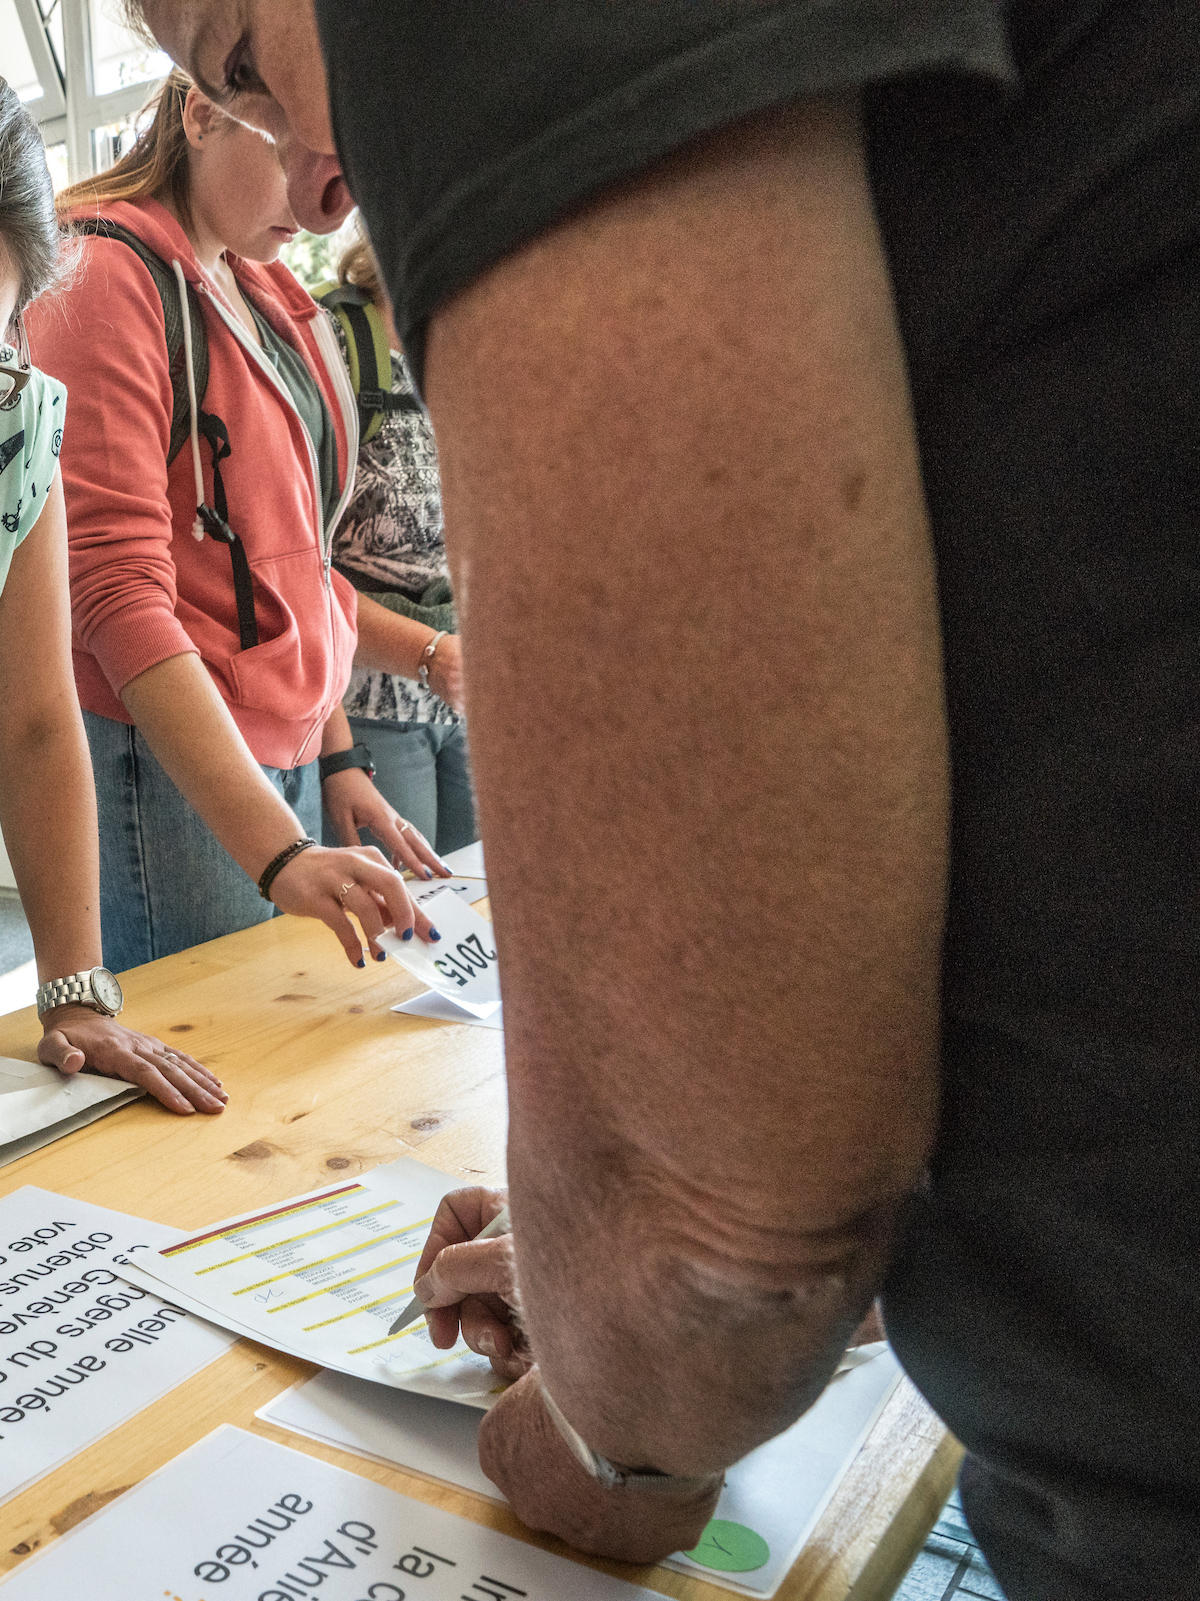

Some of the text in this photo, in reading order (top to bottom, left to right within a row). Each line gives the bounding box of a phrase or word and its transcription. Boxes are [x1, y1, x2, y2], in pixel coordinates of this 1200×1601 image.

[434, 933, 497, 987] 2015
[8, 1221, 77, 1252] vote
[104, 1299, 187, 1353] uelle
[6, 1340, 58, 1368] du
[193, 1493, 313, 1584] année
[393, 1546, 456, 1578] la
